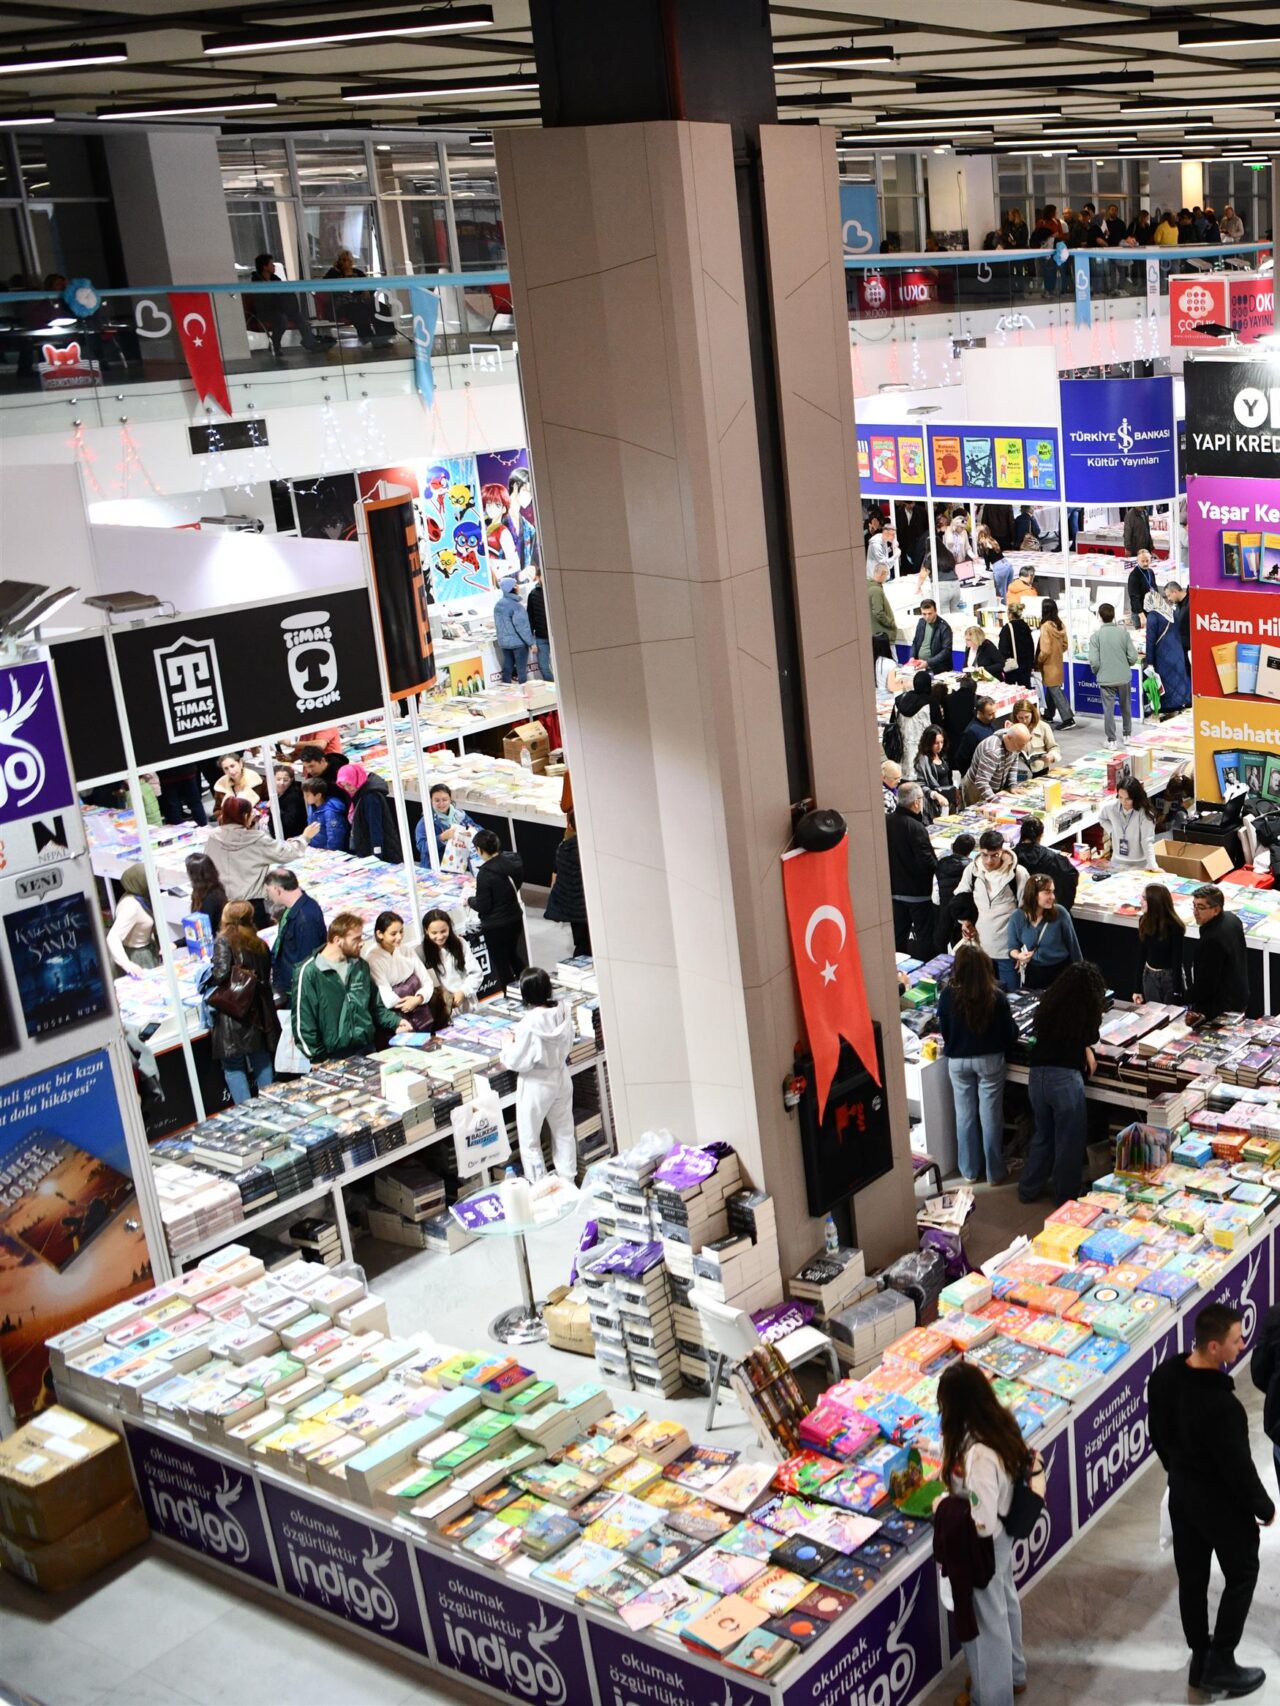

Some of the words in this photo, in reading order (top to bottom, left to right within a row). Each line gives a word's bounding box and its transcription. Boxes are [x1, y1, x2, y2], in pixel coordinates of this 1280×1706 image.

[1249, 315, 1274, 329] YAYINL
[1070, 431, 1116, 442] TÜRKİYE
[1134, 428, 1171, 441] BANKASI
[1192, 433, 1231, 452] YAPI
[1087, 456, 1119, 469] Kültür
[1121, 454, 1160, 468] Yayınları
[1197, 501, 1250, 526] Yaşar
[283, 625, 332, 649] TİMAŞ
[1196, 612, 1253, 635] Nâzım
[174, 699, 214, 718] TİMAŞ
[296, 690, 341, 714] ÇOCUK
[176, 712, 217, 732] İNANÇ
[19, 871, 59, 894] YENİ
[23, 1082, 52, 1101] genç
[55, 1071, 73, 1088] bir
[75, 1060, 104, 1079] kızın
[10, 1103, 37, 1123] dolu
[1093, 1384, 1131, 1429] okumak
[1084, 1397, 1142, 1458] özgürlüktür
[150, 1448, 196, 1477] okumak
[1086, 1414, 1150, 1504] indig
[144, 1461, 213, 1501] özgürlüktür
[149, 1481, 248, 1555] indigo
[290, 1509, 342, 1539] okumak
[281, 1522, 358, 1567] özgürlüktür
[288, 1544, 395, 1622] indigo
[448, 1580, 505, 1613] okumak
[438, 1592, 523, 1640] özgürlüktür
[443, 1613, 562, 1696] indigo
[812, 1636, 868, 1697] okumak
[621, 1653, 685, 1691] okumak
